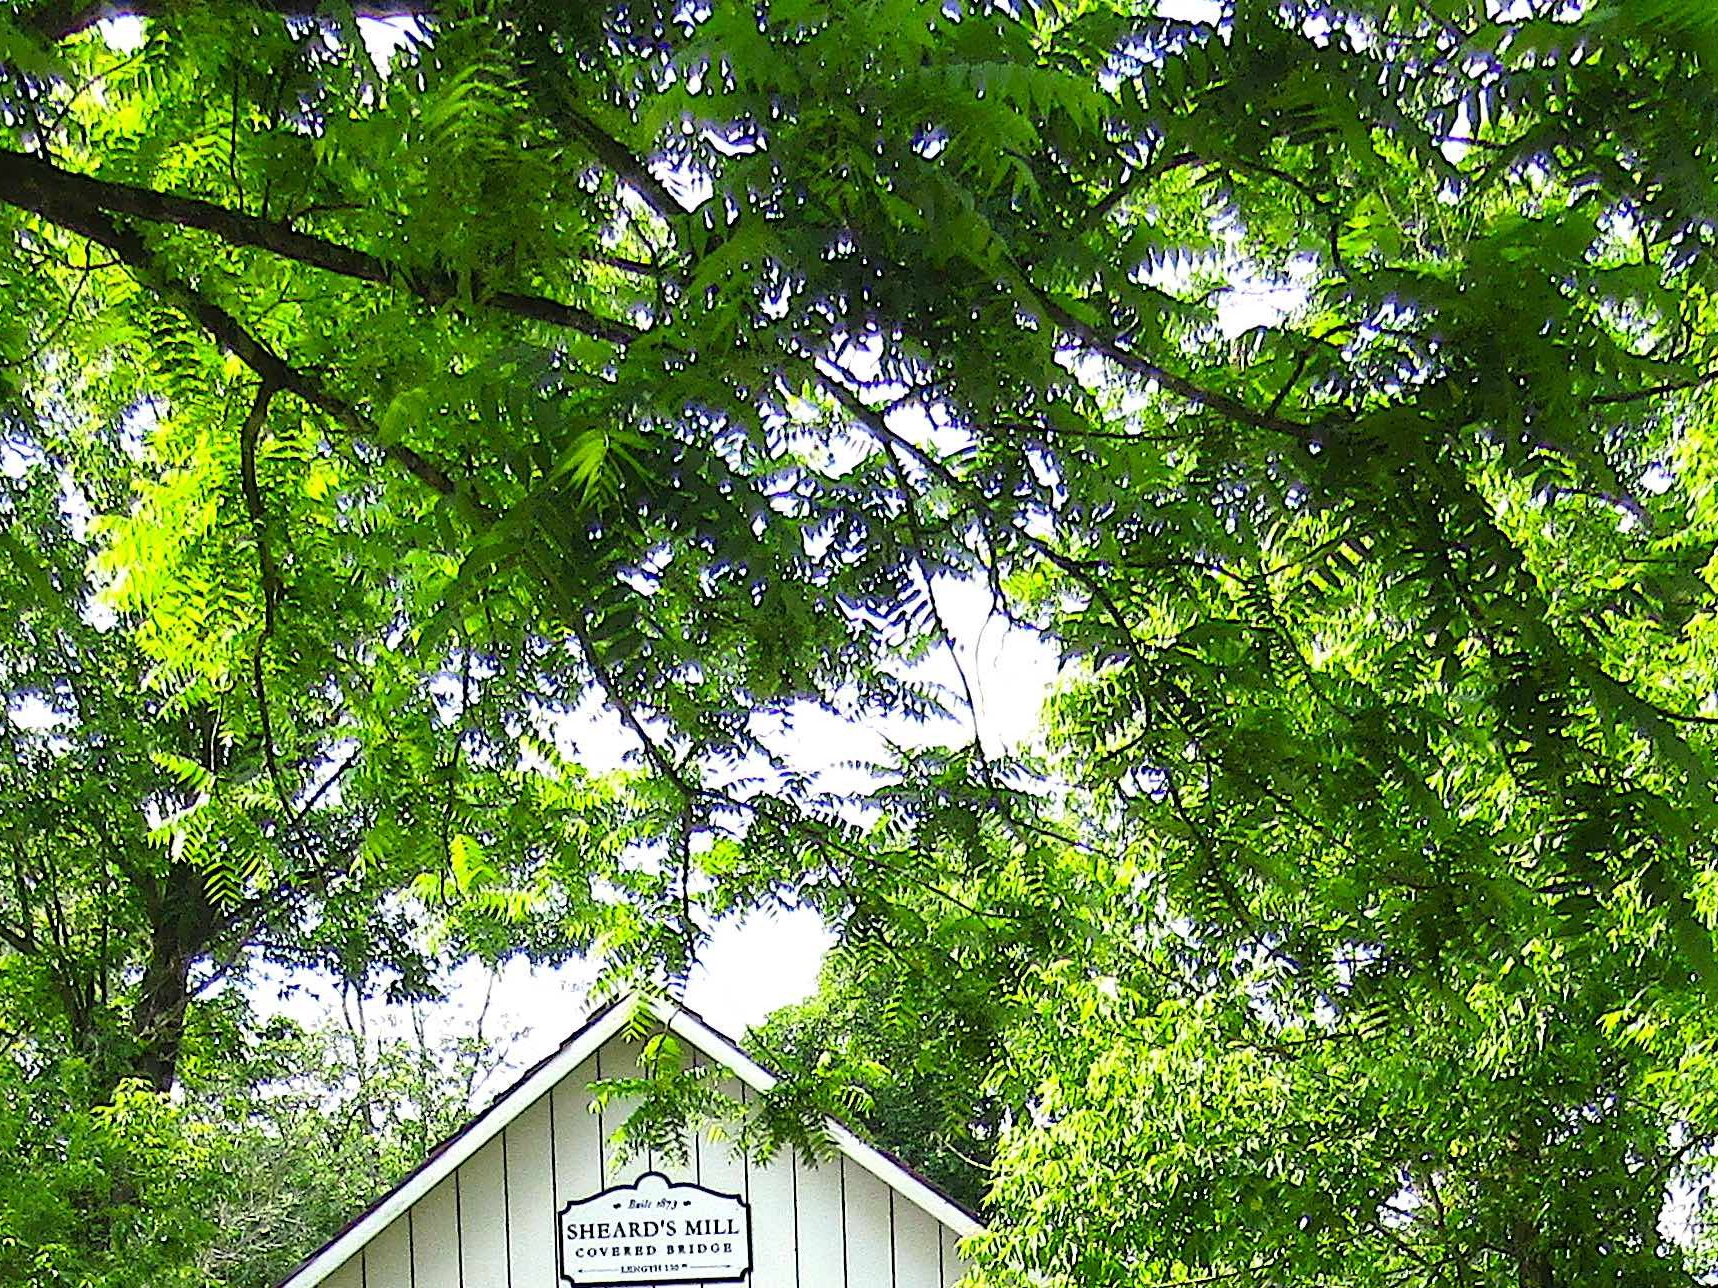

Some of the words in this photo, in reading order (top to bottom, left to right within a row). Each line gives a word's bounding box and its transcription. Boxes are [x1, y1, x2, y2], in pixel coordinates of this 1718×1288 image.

[566, 1219, 677, 1240] SHEARD'S
[685, 1218, 740, 1236] MILL
[575, 1245, 657, 1258] COVERED
[666, 1242, 733, 1255] BRIDGE
[620, 1263, 662, 1274] LENGTH
